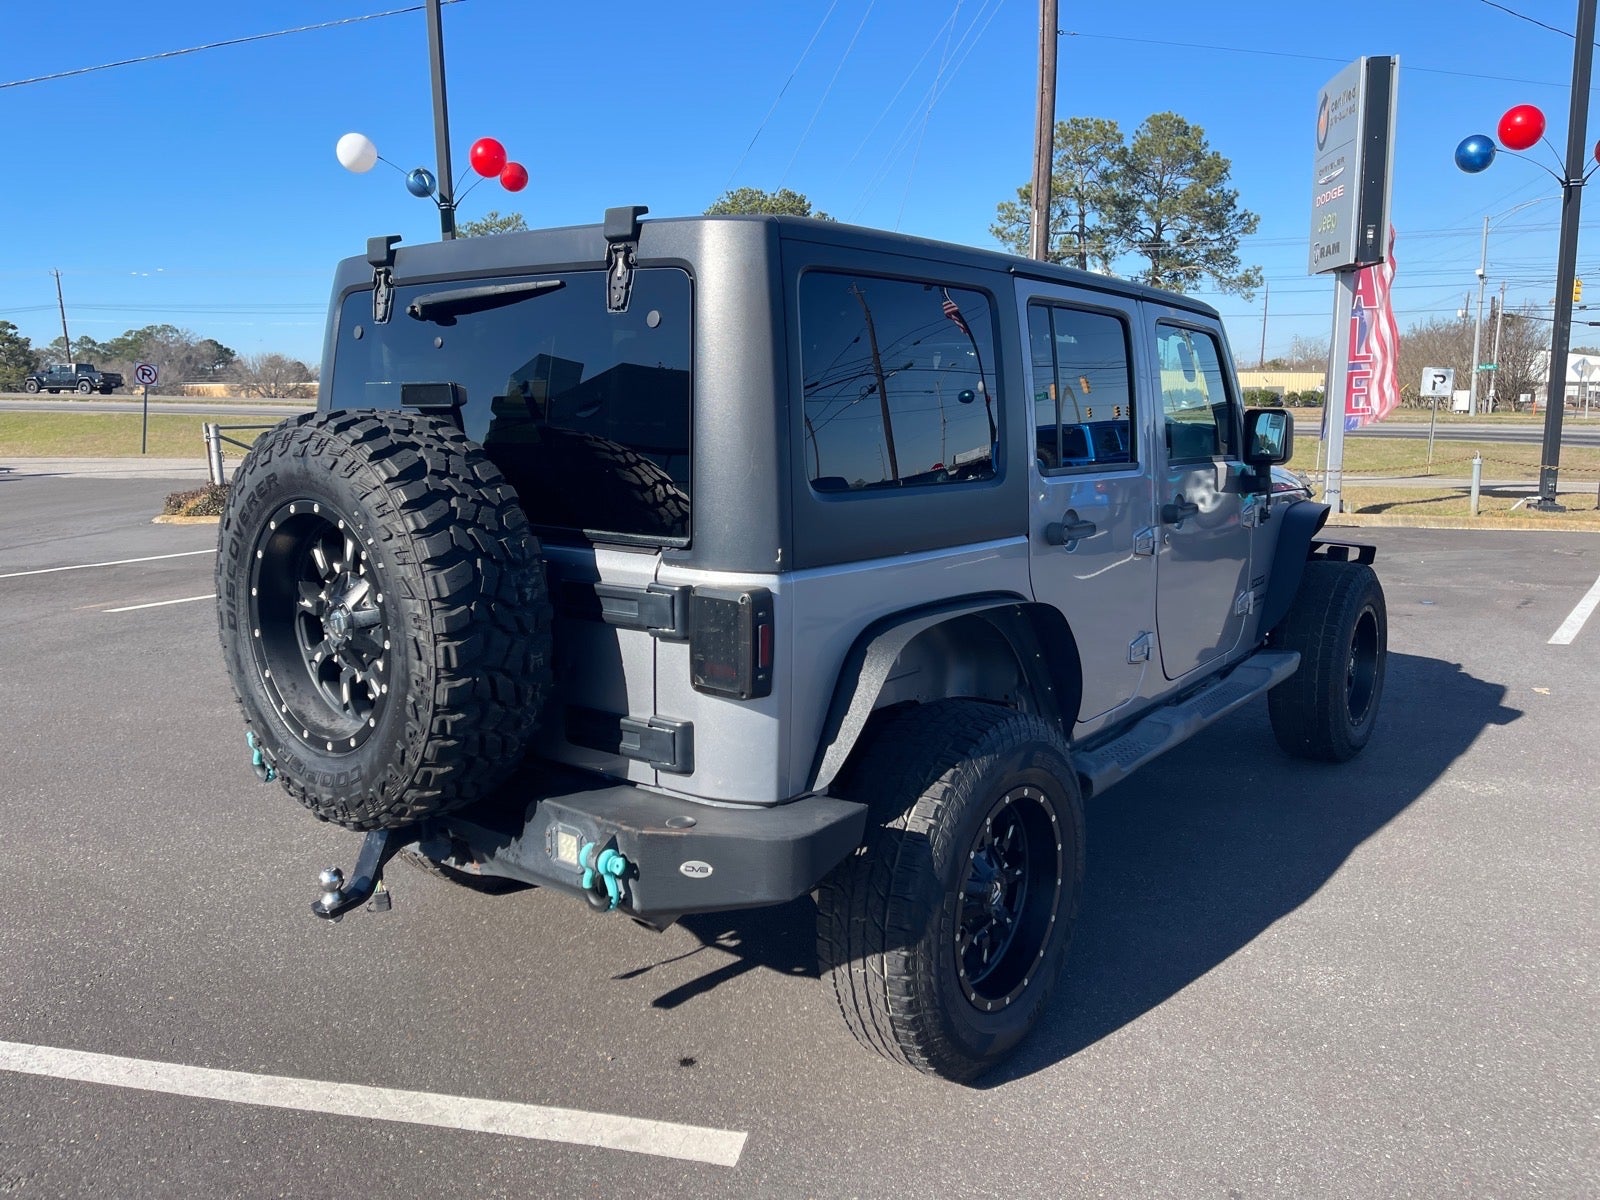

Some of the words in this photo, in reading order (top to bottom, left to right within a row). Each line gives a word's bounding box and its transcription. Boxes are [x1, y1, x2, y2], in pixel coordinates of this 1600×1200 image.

[1316, 184, 1345, 208] DODGE
[1317, 211, 1337, 234] Jeep
[1320, 242, 1340, 258] RAM
[1345, 266, 1379, 416] ALE
[225, 471, 280, 632] DISCOVERER
[277, 745, 361, 788] COOPER
